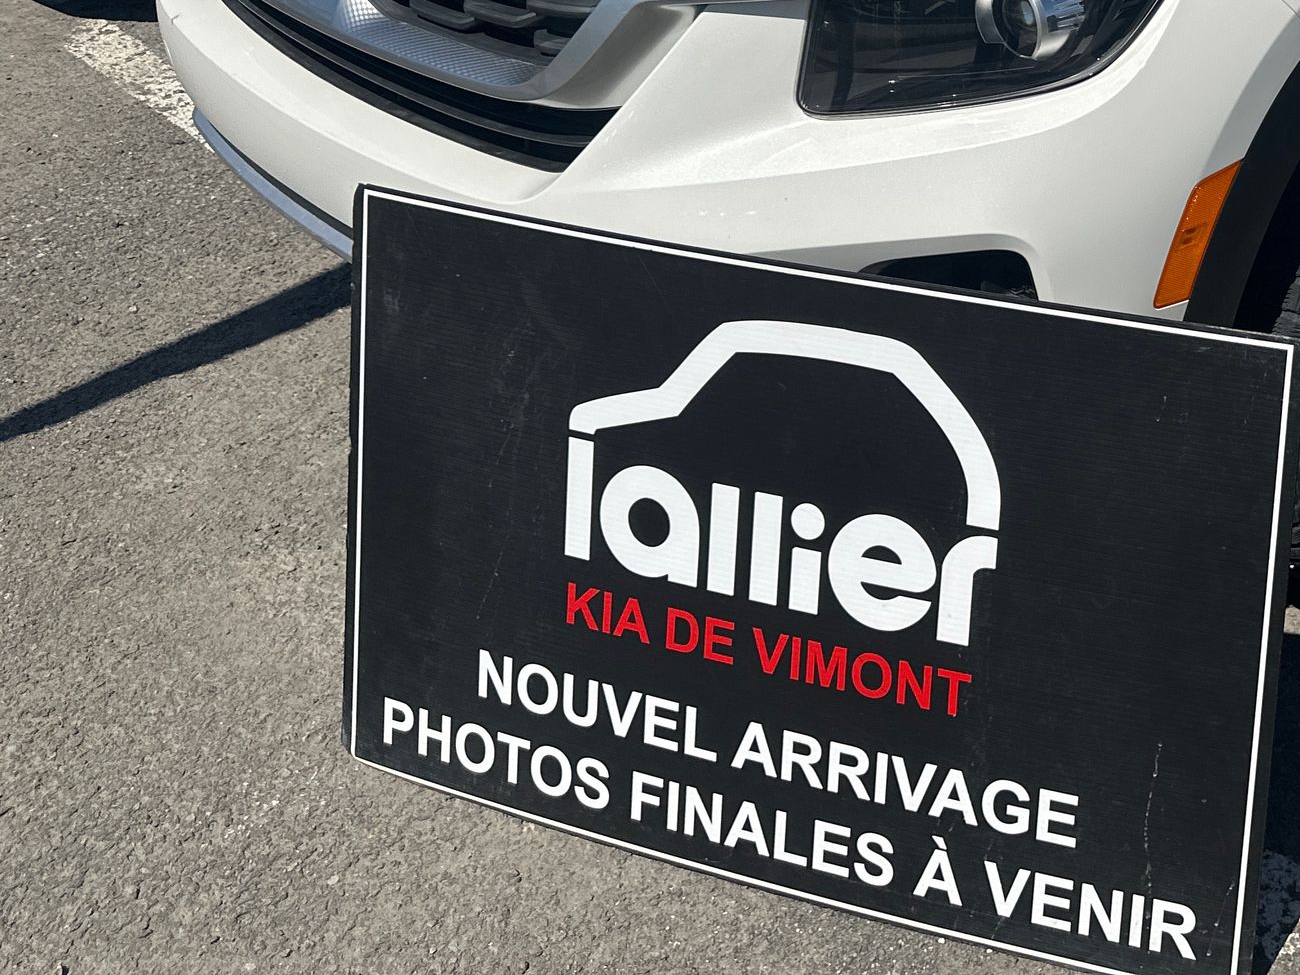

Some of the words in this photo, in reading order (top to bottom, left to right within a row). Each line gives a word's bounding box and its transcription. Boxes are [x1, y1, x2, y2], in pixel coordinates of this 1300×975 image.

[477, 648, 718, 763] NOUVEL
[730, 720, 1080, 849] ARRIVAGE
[566, 581, 650, 645] KIA
[665, 606, 736, 666] DE
[752, 627, 973, 717] VIMONT
[382, 696, 611, 810] PHOTOS
[629, 770, 895, 888] FINALES
[912, 835, 963, 907] À
[983, 859, 1198, 961] VENIR
